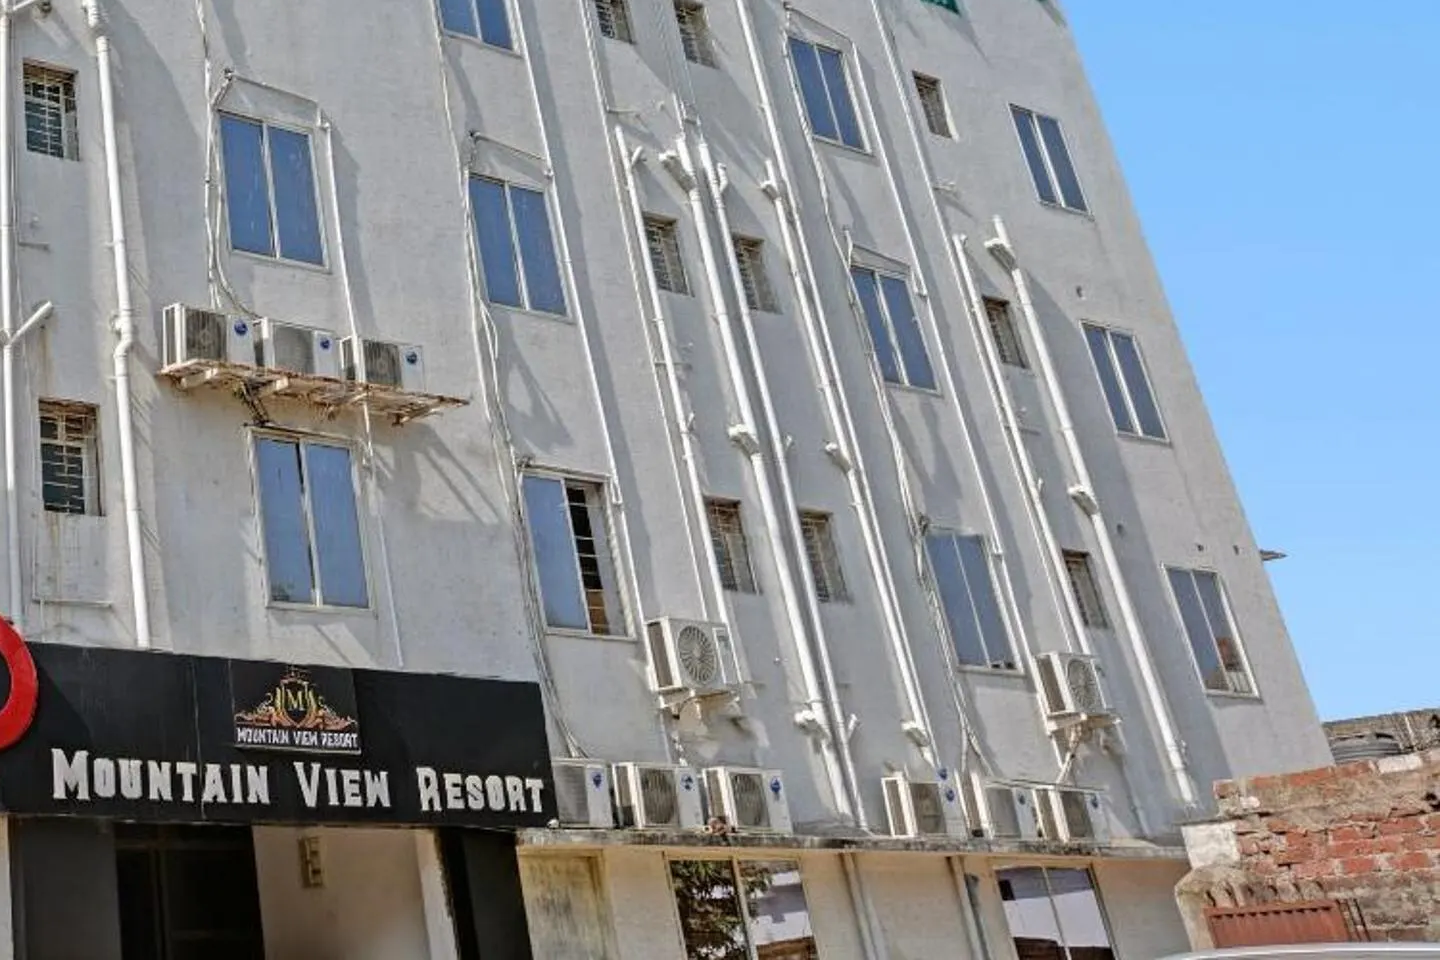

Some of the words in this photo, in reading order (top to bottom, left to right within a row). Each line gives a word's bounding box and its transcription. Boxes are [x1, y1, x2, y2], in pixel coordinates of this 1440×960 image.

[50, 747, 271, 805] MOUNTAIN
[293, 761, 392, 808] VIEW
[416, 766, 545, 813] RESORT
